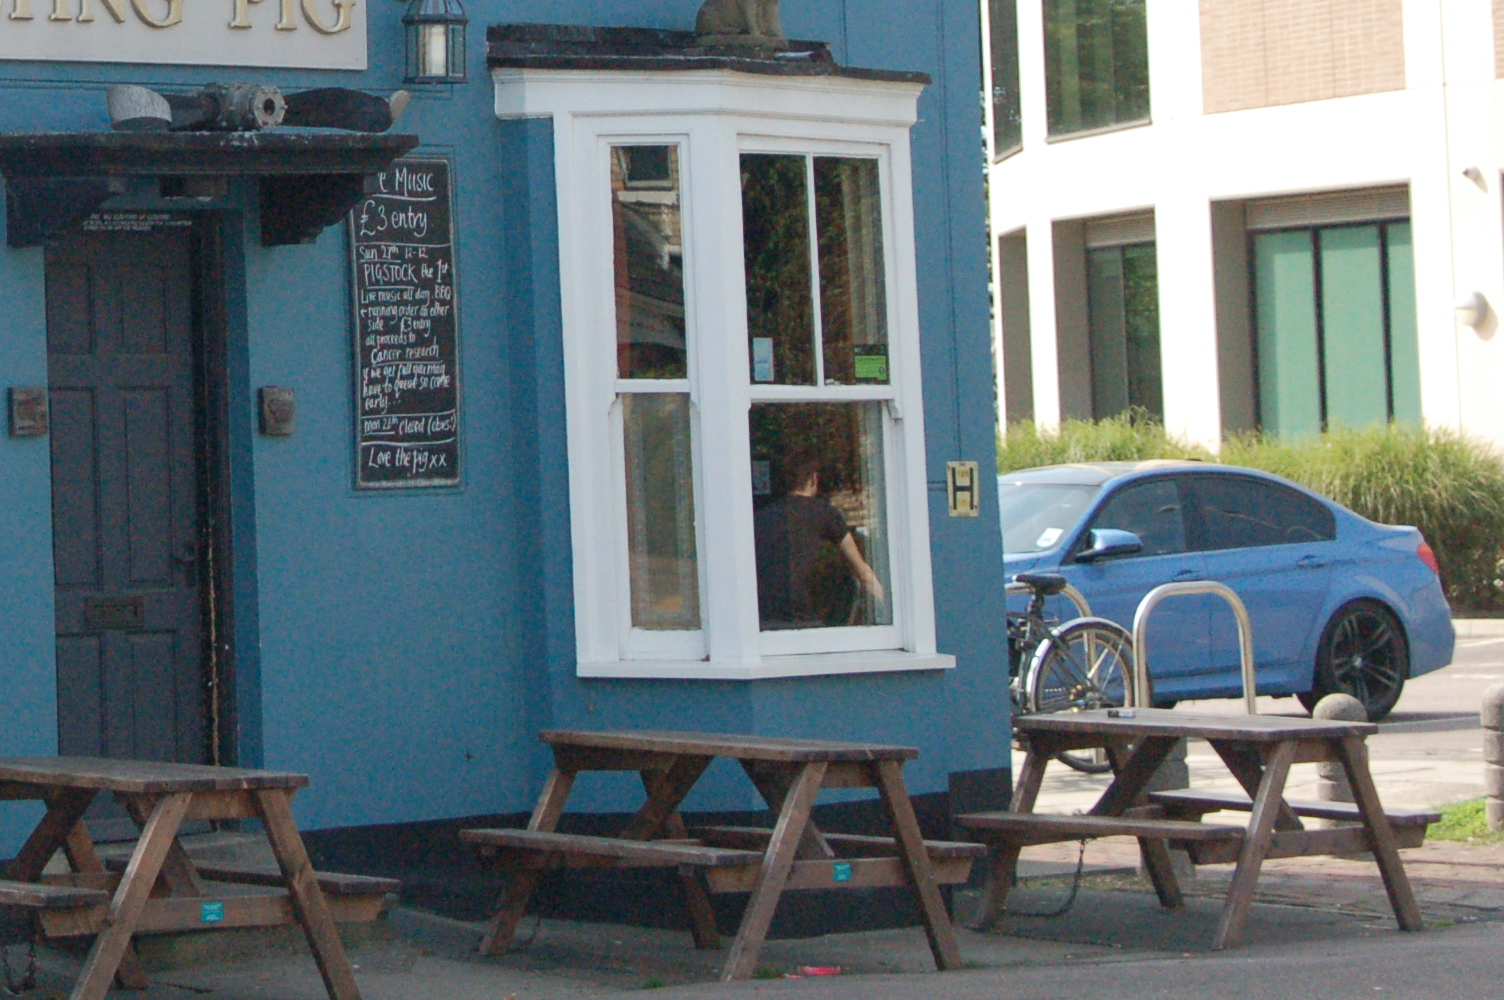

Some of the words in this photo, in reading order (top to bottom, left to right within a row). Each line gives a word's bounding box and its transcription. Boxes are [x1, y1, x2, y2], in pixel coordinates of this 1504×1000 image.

[360, 200, 388, 236] £3
[391, 205, 427, 237] entry
[359, 245, 377, 260] Sun
[364, 263, 418, 286] PIGSTOCK
[434, 284, 451, 300] BBQ
[369, 447, 392, 467] Love
[395, 445, 412, 467] the
[413, 447, 428, 474] pig
[951, 466, 974, 511] H
